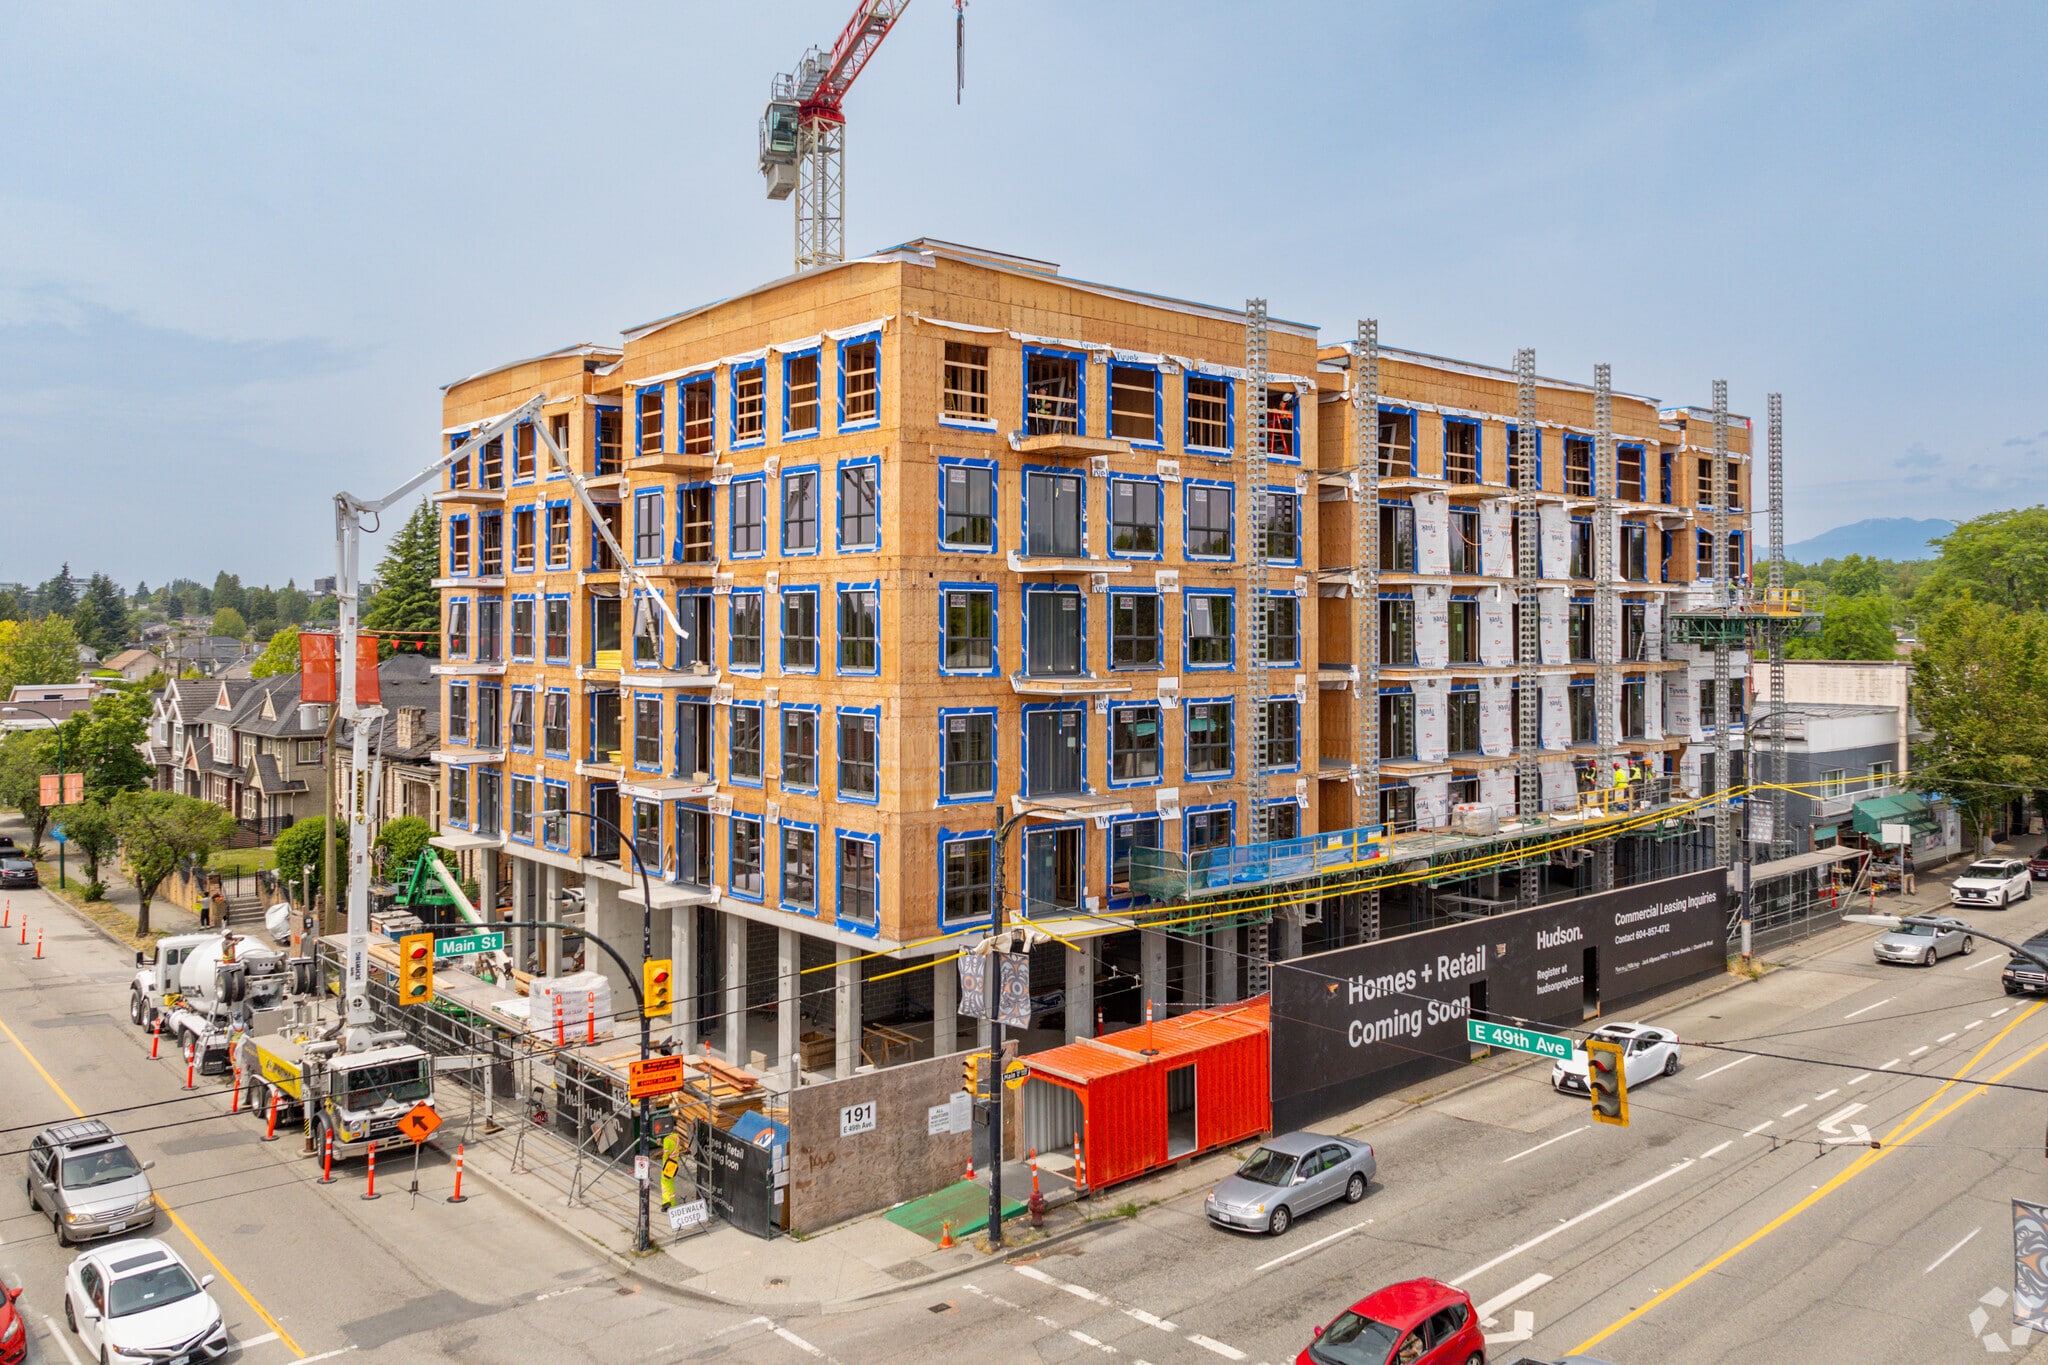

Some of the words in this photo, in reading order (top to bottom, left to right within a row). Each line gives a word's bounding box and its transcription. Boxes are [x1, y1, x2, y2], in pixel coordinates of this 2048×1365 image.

[1116, 352, 1139, 361] Tyvek
[1669, 687, 1688, 695] Tyvek
[1614, 905, 1659, 926] Commercial
[1660, 899, 1687, 915] Leasing
[1688, 891, 1717, 909] Inquiries
[1537, 925, 1583, 950] Hudson.
[1614, 931, 1635, 945] Contact
[1636, 924, 1670, 940] 604-857-4712
[442, 938, 475, 954] Main
[481, 936, 497, 949] St
[1348, 968, 1416, 1004] Homes
[1421, 963, 1433, 983] +
[1437, 944, 1486, 982] Retail
[1537, 967, 1561, 981] Register
[1561, 964, 1568, 974] at
[1537, 975, 1584, 995] hudsonprojects.c
[1348, 1009, 1422, 1047] Coming
[1427, 995, 1471, 1025] Soon
[1475, 1024, 1486, 1040] E
[1492, 1028, 1529, 1048] 49th
[1536, 1037, 1565, 1056] Ave
[845, 1104, 871, 1123] 191
[849, 1124, 861, 1132] 49th
[726, 1141, 745, 1160] Retail
[670, 1202, 705, 1218] SIDEWALK
[676, 1213, 701, 1226] CLOSED
